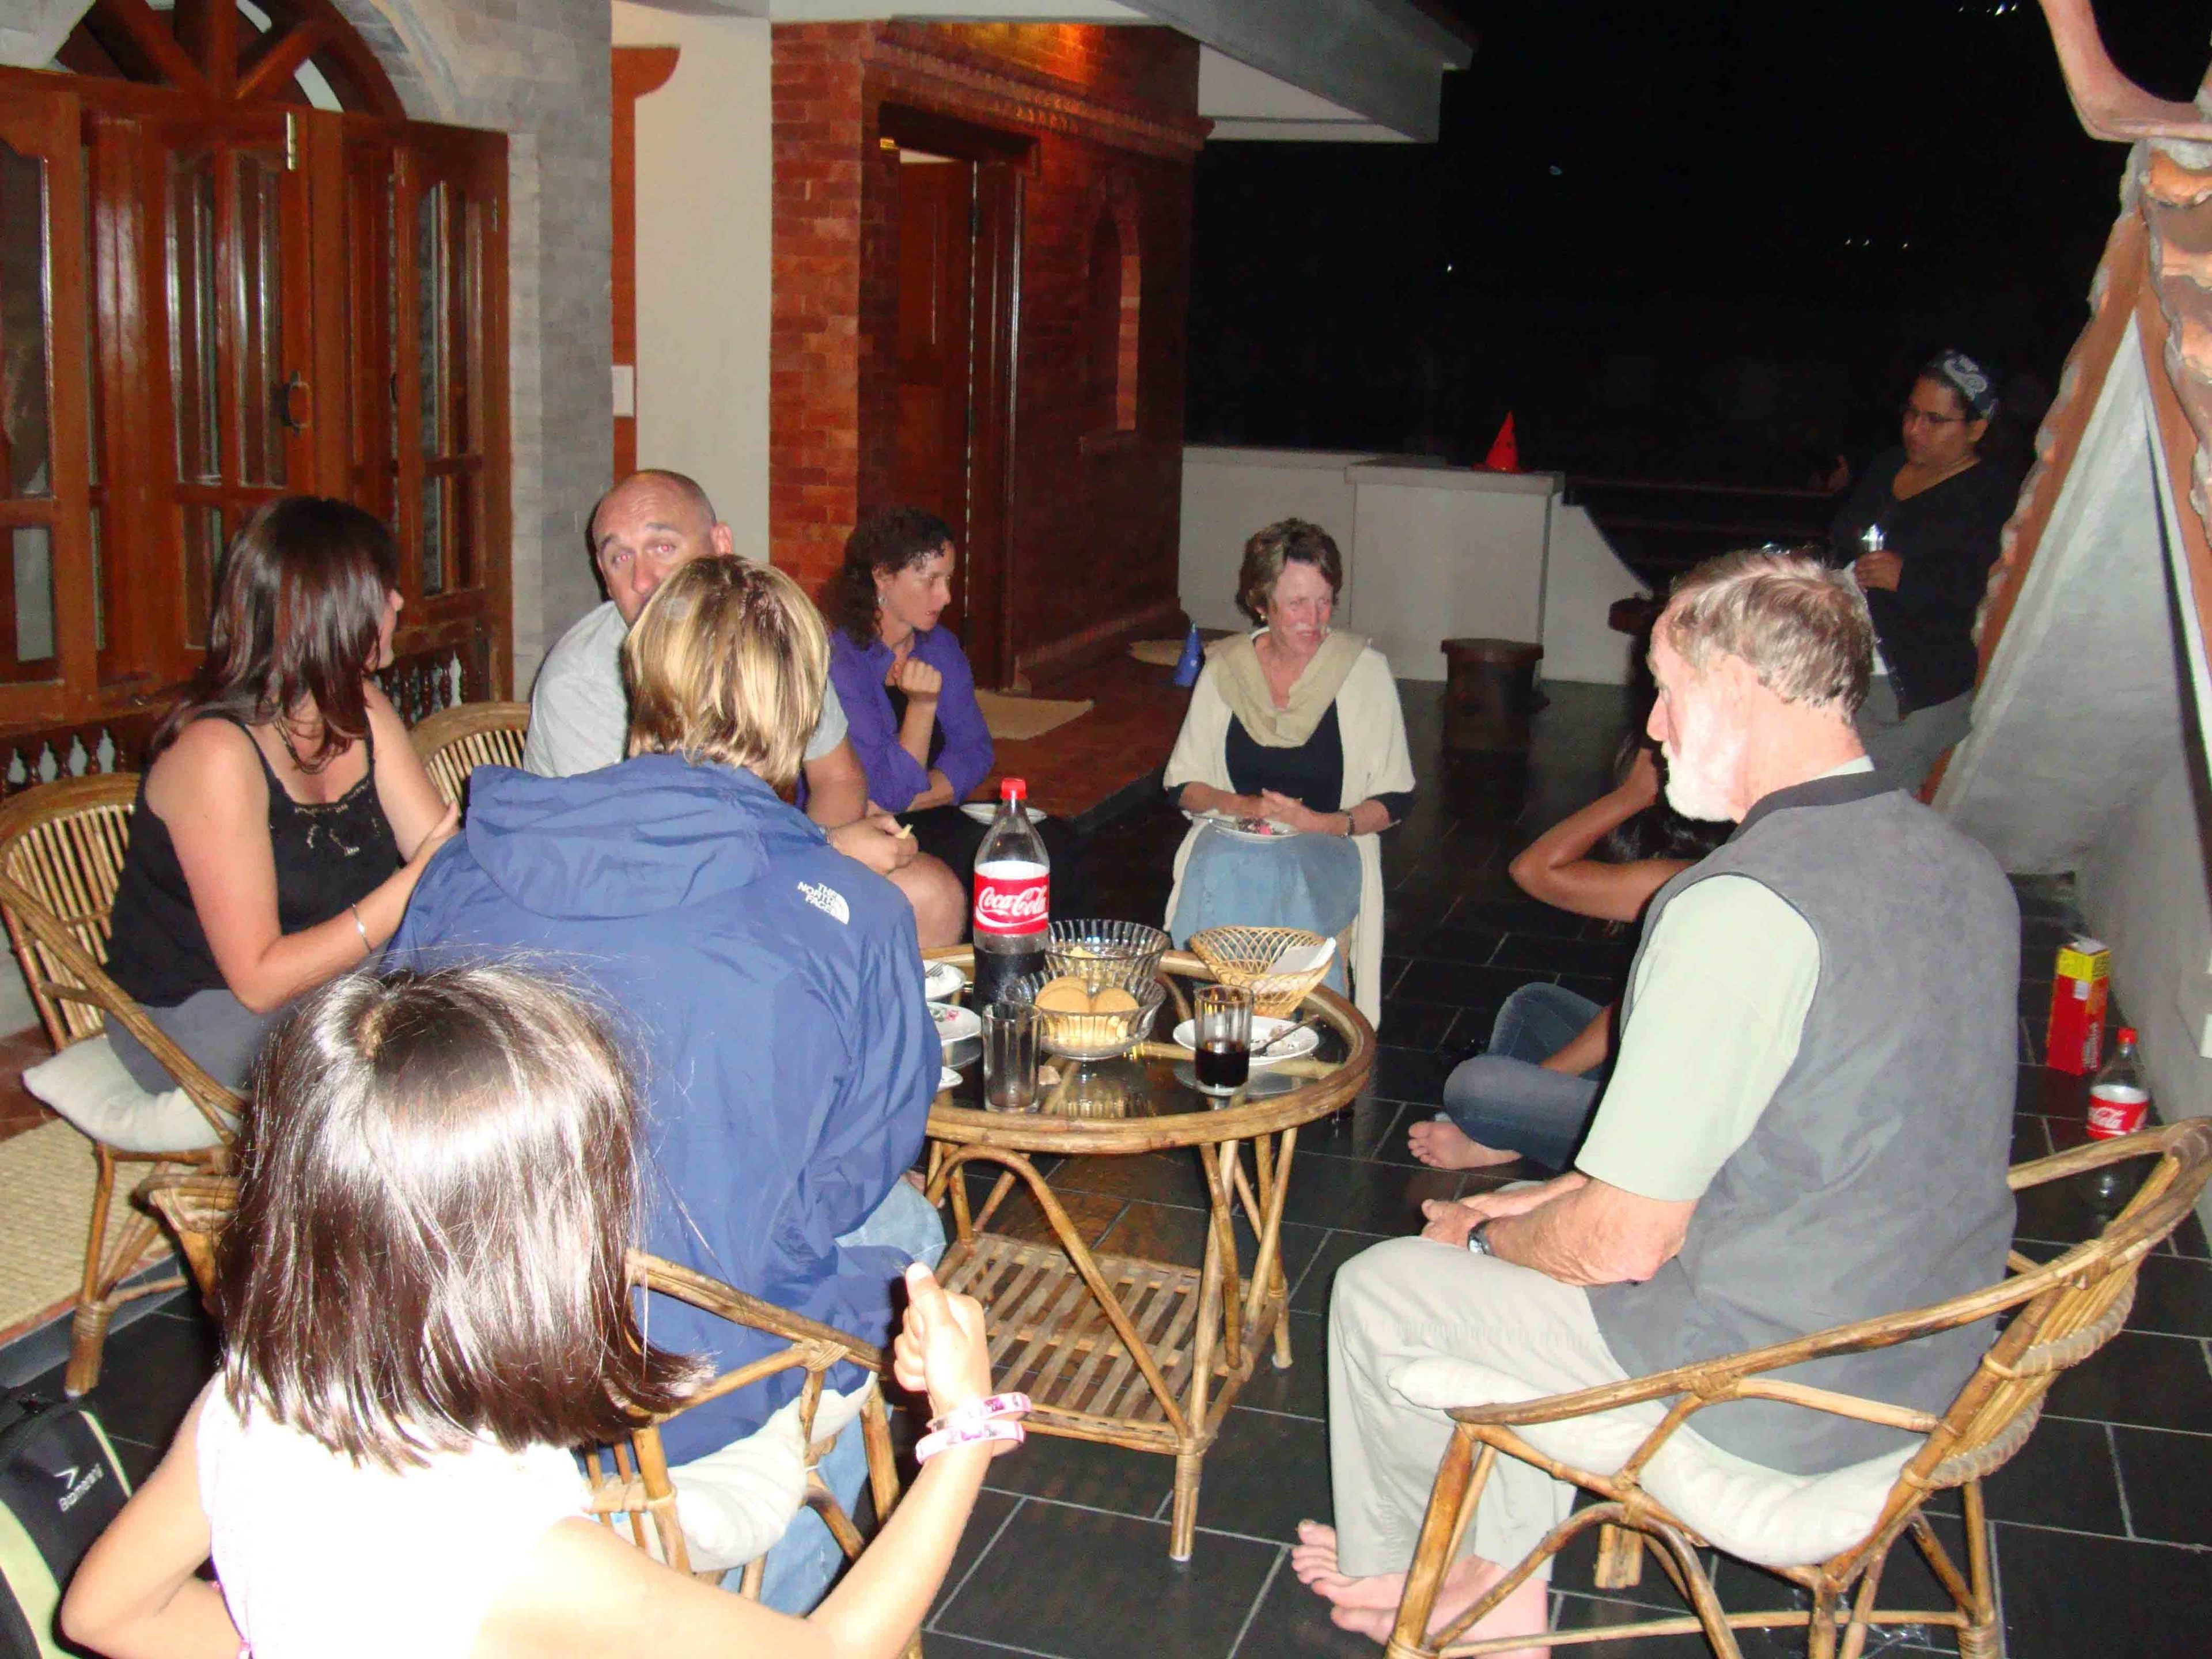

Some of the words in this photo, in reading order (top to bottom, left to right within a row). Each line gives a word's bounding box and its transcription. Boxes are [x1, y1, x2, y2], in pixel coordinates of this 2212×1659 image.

[797, 881, 835, 907] NORTH
[817, 882, 838, 900] THE
[979, 885, 1047, 916] Coca-Cola
[805, 893, 832, 914] FACE
